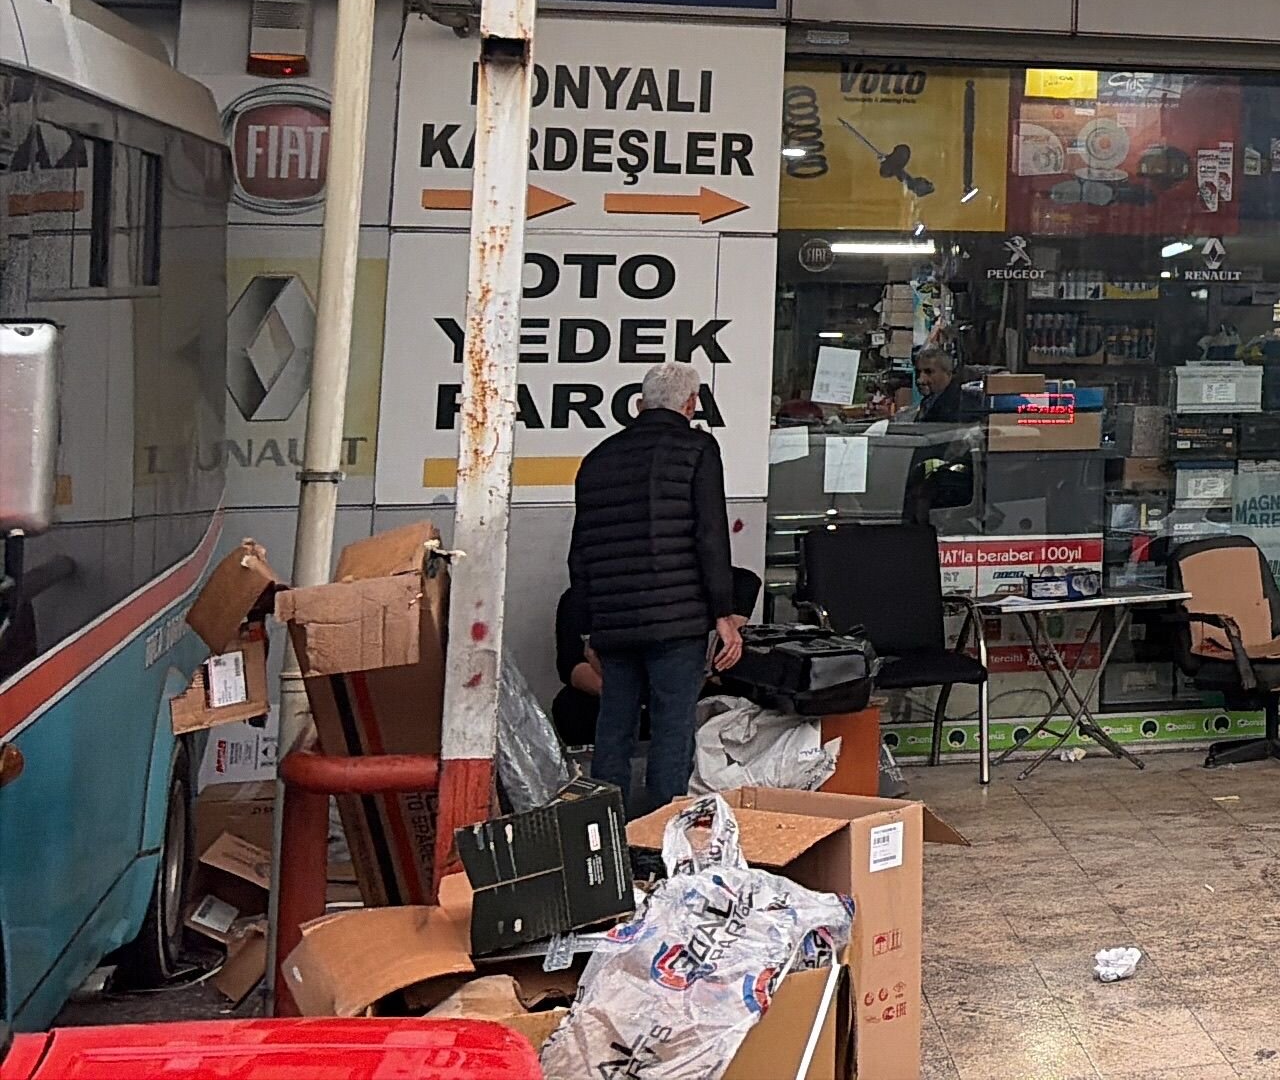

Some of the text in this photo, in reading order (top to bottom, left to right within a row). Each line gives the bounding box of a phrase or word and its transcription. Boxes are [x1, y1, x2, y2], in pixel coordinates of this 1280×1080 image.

[245, 124, 330, 179] FIAT
[987, 269, 1046, 280] PEUGEOT
[1184, 270, 1242, 281] RENAULT
[977, 548, 1034, 563] beraber
[1041, 546, 1082, 563] 100yıl
